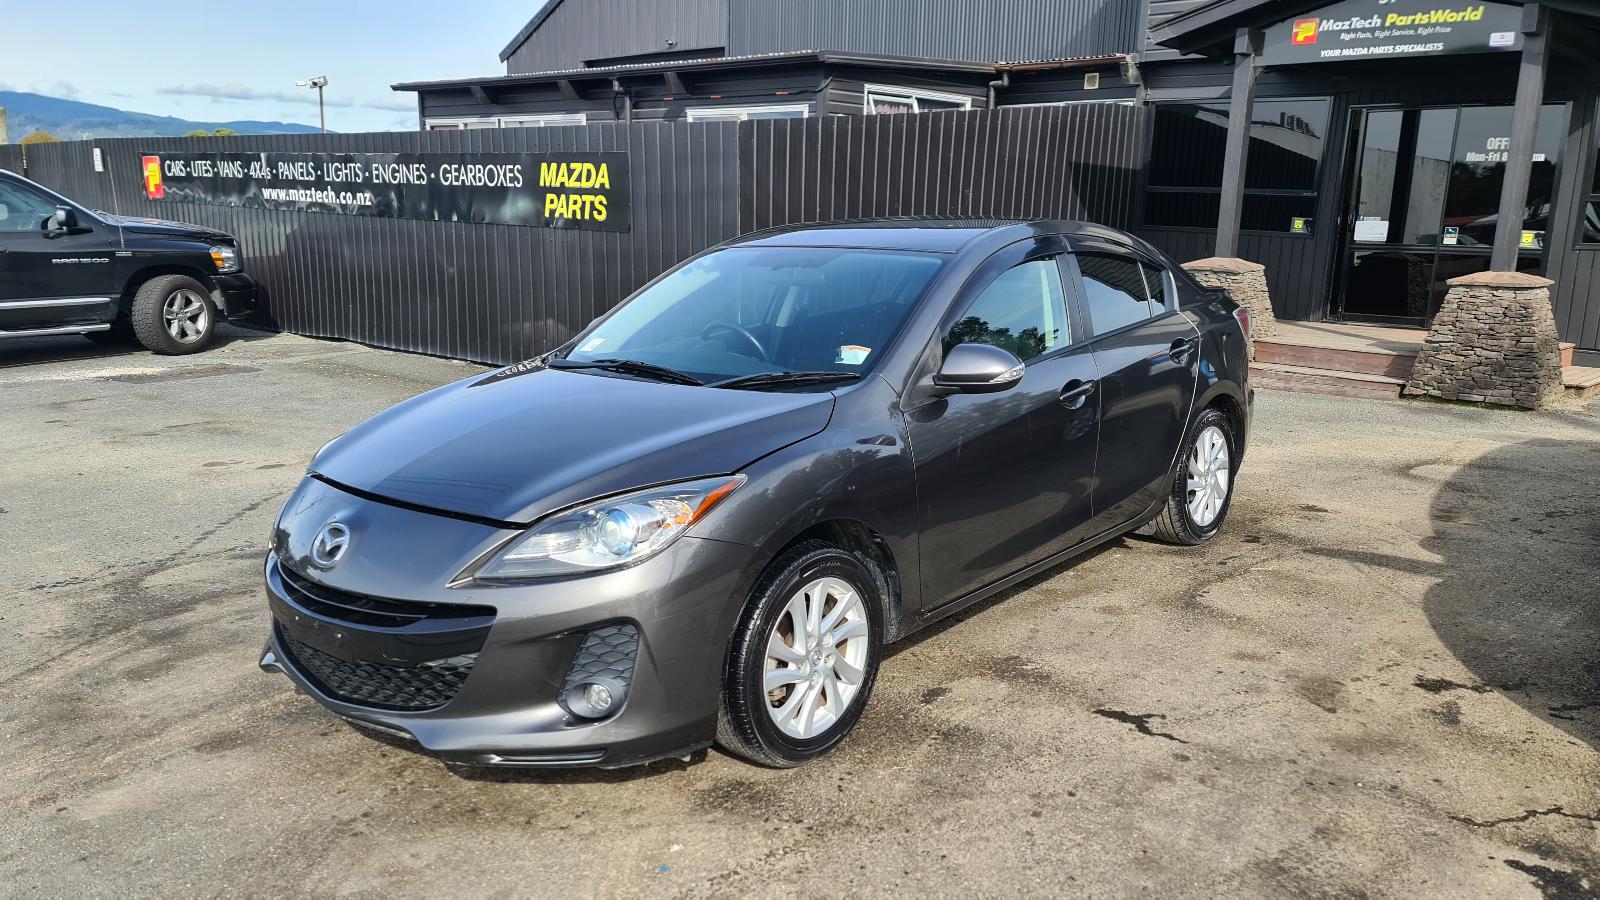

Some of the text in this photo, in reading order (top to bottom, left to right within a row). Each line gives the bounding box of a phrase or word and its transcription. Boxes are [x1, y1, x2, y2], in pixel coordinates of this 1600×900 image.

[1319, 6, 1484, 32] MazTech PartsWorld
[1340, 31, 1356, 41] Right
[1374, 29, 1391, 38] Right
[1417, 26, 1434, 36] Right
[1320, 42, 1444, 57] YOUR MAZDA PARTS SPECIALISTS
[1486, 137, 1511, 149] OFF
[1465, 152, 1501, 162] Mon-Fri
[164, 160, 186, 177] CARS
[190, 160, 213, 177] UTES
[217, 160, 243, 178] VANS
[278, 161, 316, 181] PANELS
[323, 162, 363, 183] LIGHTS
[372, 163, 427, 185] ENGINES
[439, 164, 523, 188] GEARBOXES
[539, 162, 610, 190] MAZDA
[261, 185, 372, 206] www.maztech.co.nz
[544, 193, 608, 222] PARTS
